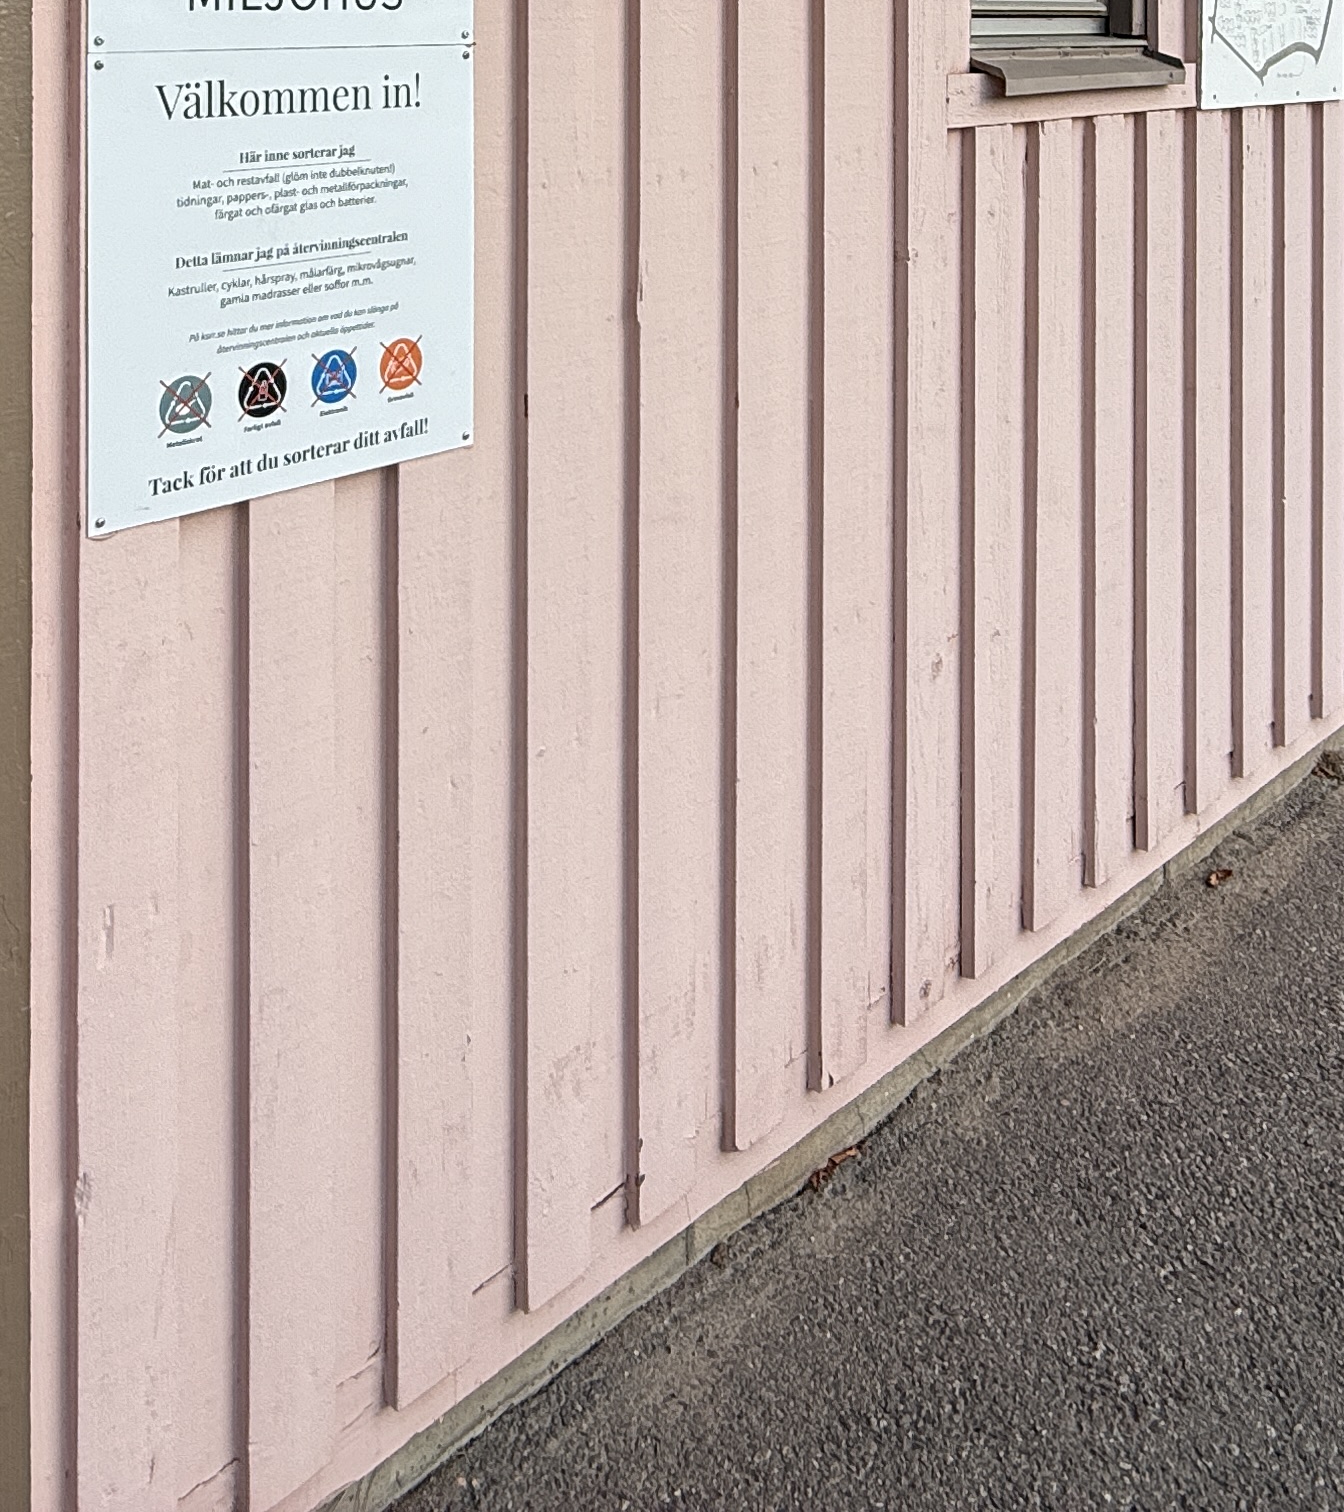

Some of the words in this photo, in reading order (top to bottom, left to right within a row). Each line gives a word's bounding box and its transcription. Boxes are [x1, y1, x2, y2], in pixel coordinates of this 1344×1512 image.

[155, 79, 372, 120] Välkommen
[382, 72, 421, 108] in!
[240, 151, 262, 164] Här
[265, 150, 290, 162] inne
[292, 148, 337, 160] sorterar
[338, 144, 355, 159] jag
[192, 179, 214, 189] Mat-
[216, 177, 234, 188] och
[237, 173, 280, 186] restavfall
[282, 172, 308, 185] (glöm
[311, 170, 327, 180] inte
[176, 194, 224, 207] tidningar,
[274, 187, 300, 200] plast-
[301, 185, 318, 196] och
[215, 208, 242, 221] färgat
[244, 205, 262, 216] och
[264, 202, 297, 216] ofärgat
[299, 201, 317, 214] glas
[320, 198, 335, 209] och
[175, 255, 208, 269] Detta
[211, 251, 254, 265] lämnar
[254, 246, 274, 262] jag
[276, 243, 290, 259] på
[293, 231, 408, 255] återvinningscentralen
[168, 282, 219, 297] Kastruller,
[221, 278, 253, 292] cyklar,
[254, 272, 297, 286] hårspray,
[220, 293, 249, 308] gamla
[252, 287, 300, 301] madrasser
[303, 282, 322, 294] eller
[324, 279, 349, 291] soffor
[148, 470, 194, 496] Tack
[199, 465, 226, 486] för
[230, 458, 252, 478] att
[257, 453, 278, 472] du
[283, 439, 350, 466] sorterar
[354, 429, 379, 450] ditt
[384, 417, 428, 443] avfall!
